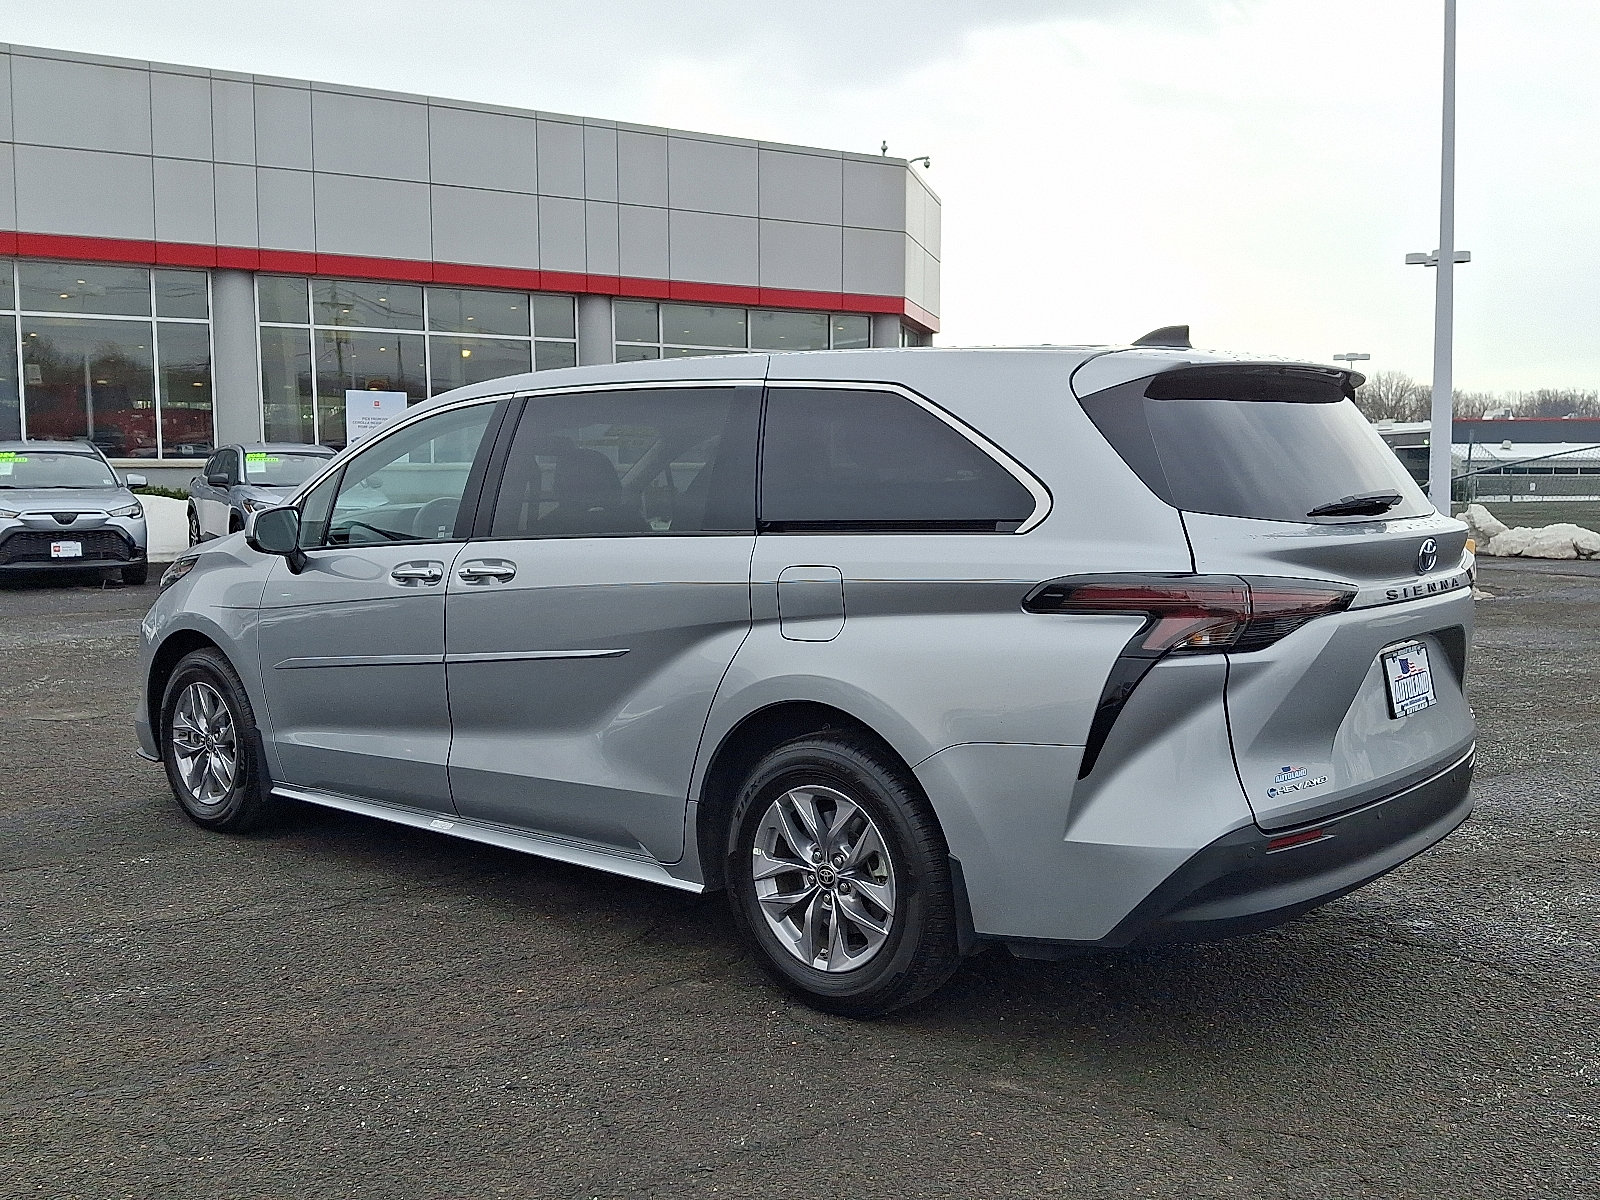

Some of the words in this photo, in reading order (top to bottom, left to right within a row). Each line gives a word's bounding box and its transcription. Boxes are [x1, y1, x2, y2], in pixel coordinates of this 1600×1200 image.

[1386, 578, 1460, 601] SIENNA
[1395, 672, 1430, 704] AUTOLAND
[1275, 767, 1307, 783] AUTOLAND
